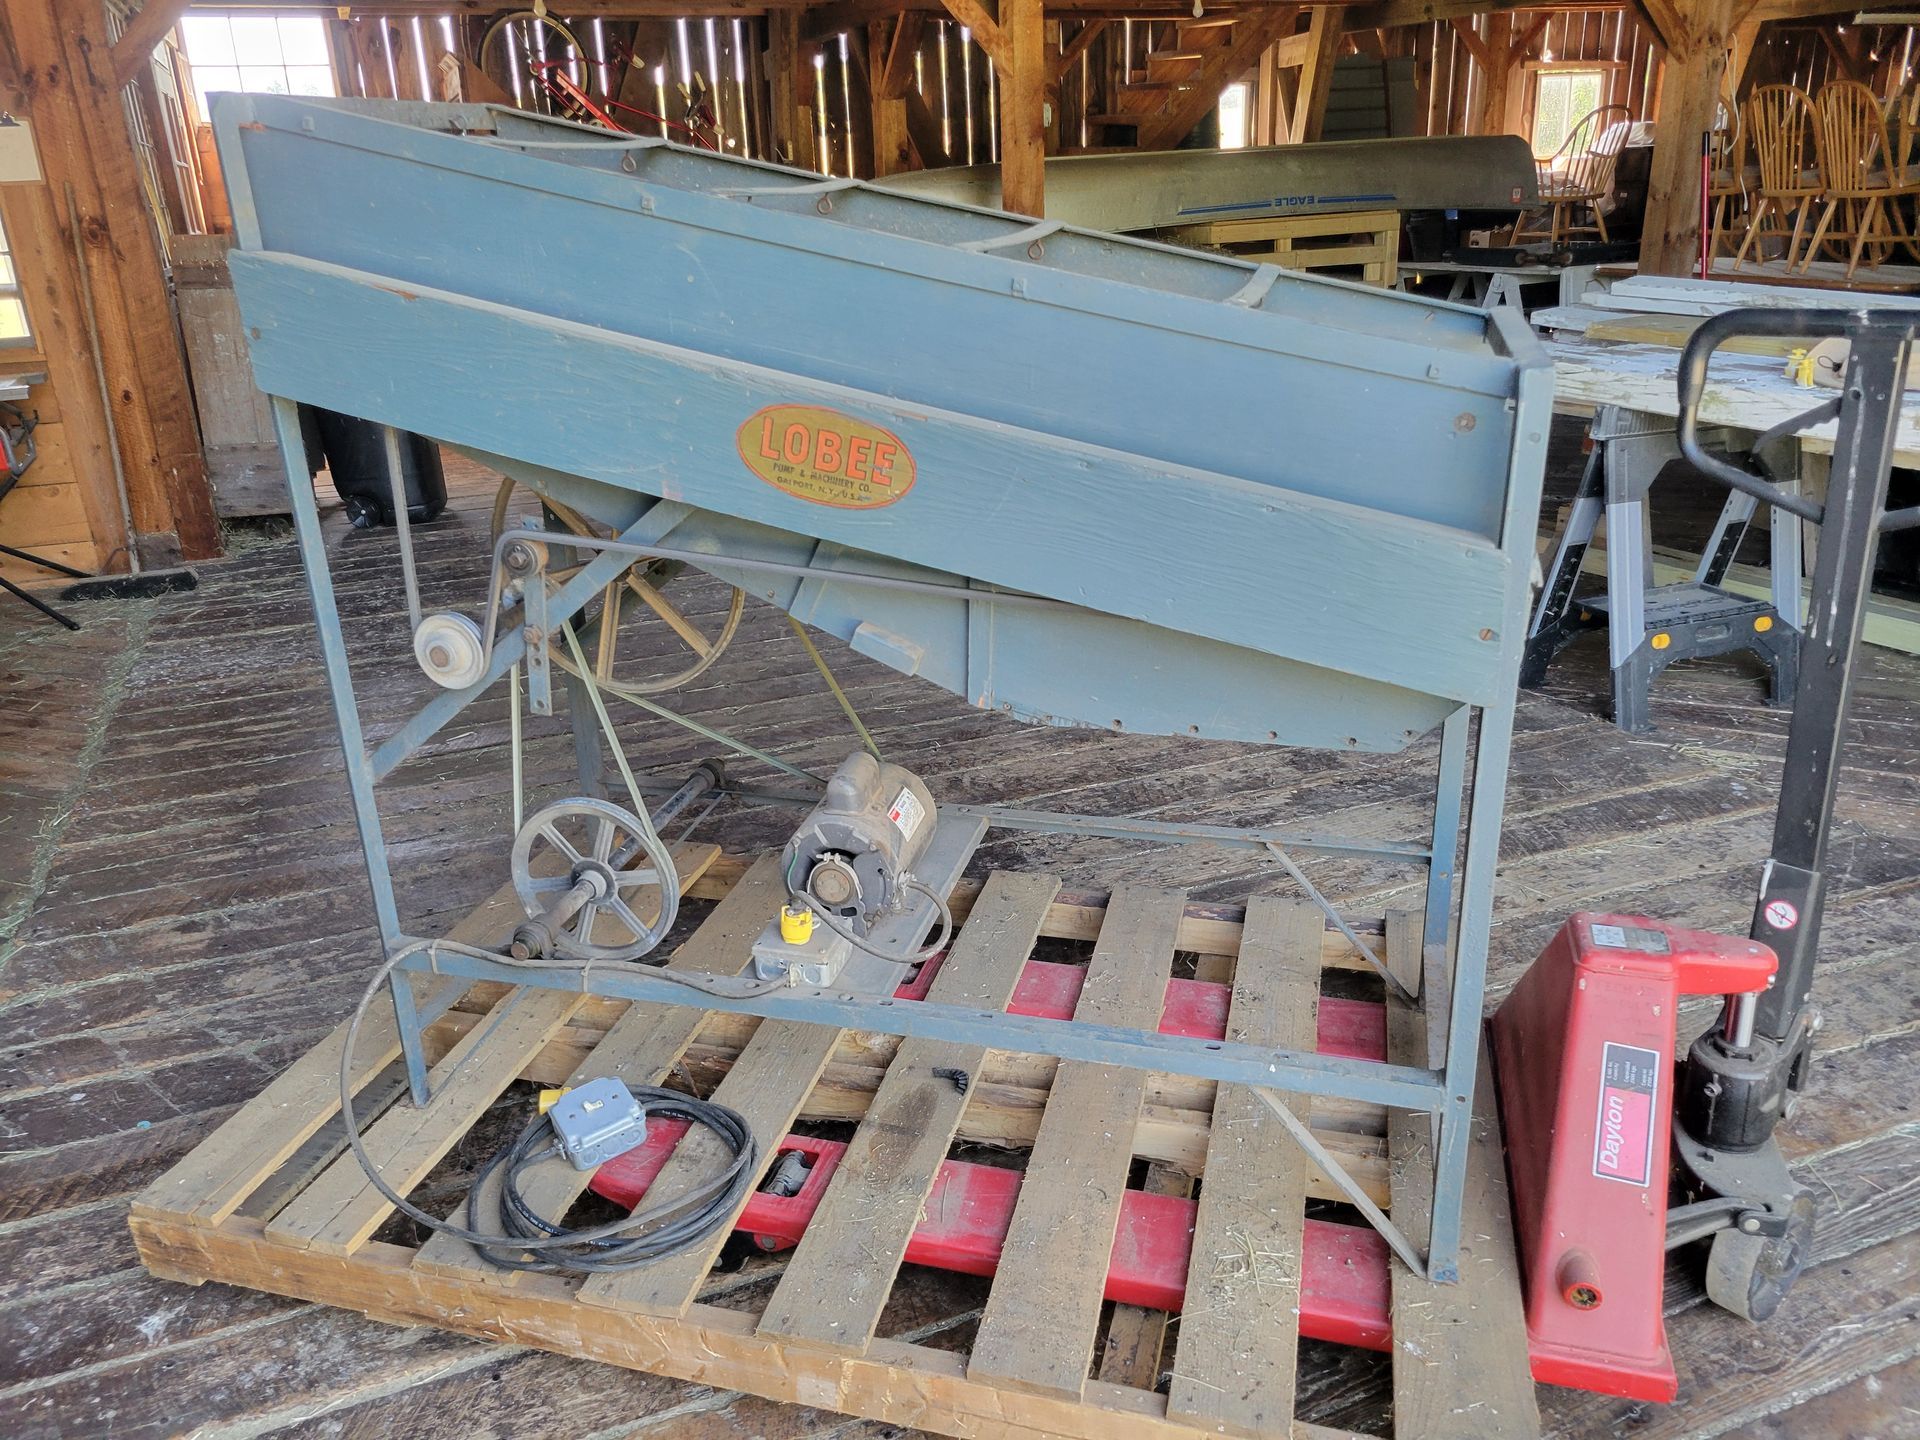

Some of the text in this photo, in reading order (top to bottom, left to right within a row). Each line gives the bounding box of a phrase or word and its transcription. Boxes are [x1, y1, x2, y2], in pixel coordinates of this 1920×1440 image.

[1275, 195, 1315, 207] EAGLE
[760, 416, 897, 486] LOBEE
[858, 483, 872, 494] CO.
[1600, 1095, 1625, 1169] Dayton
